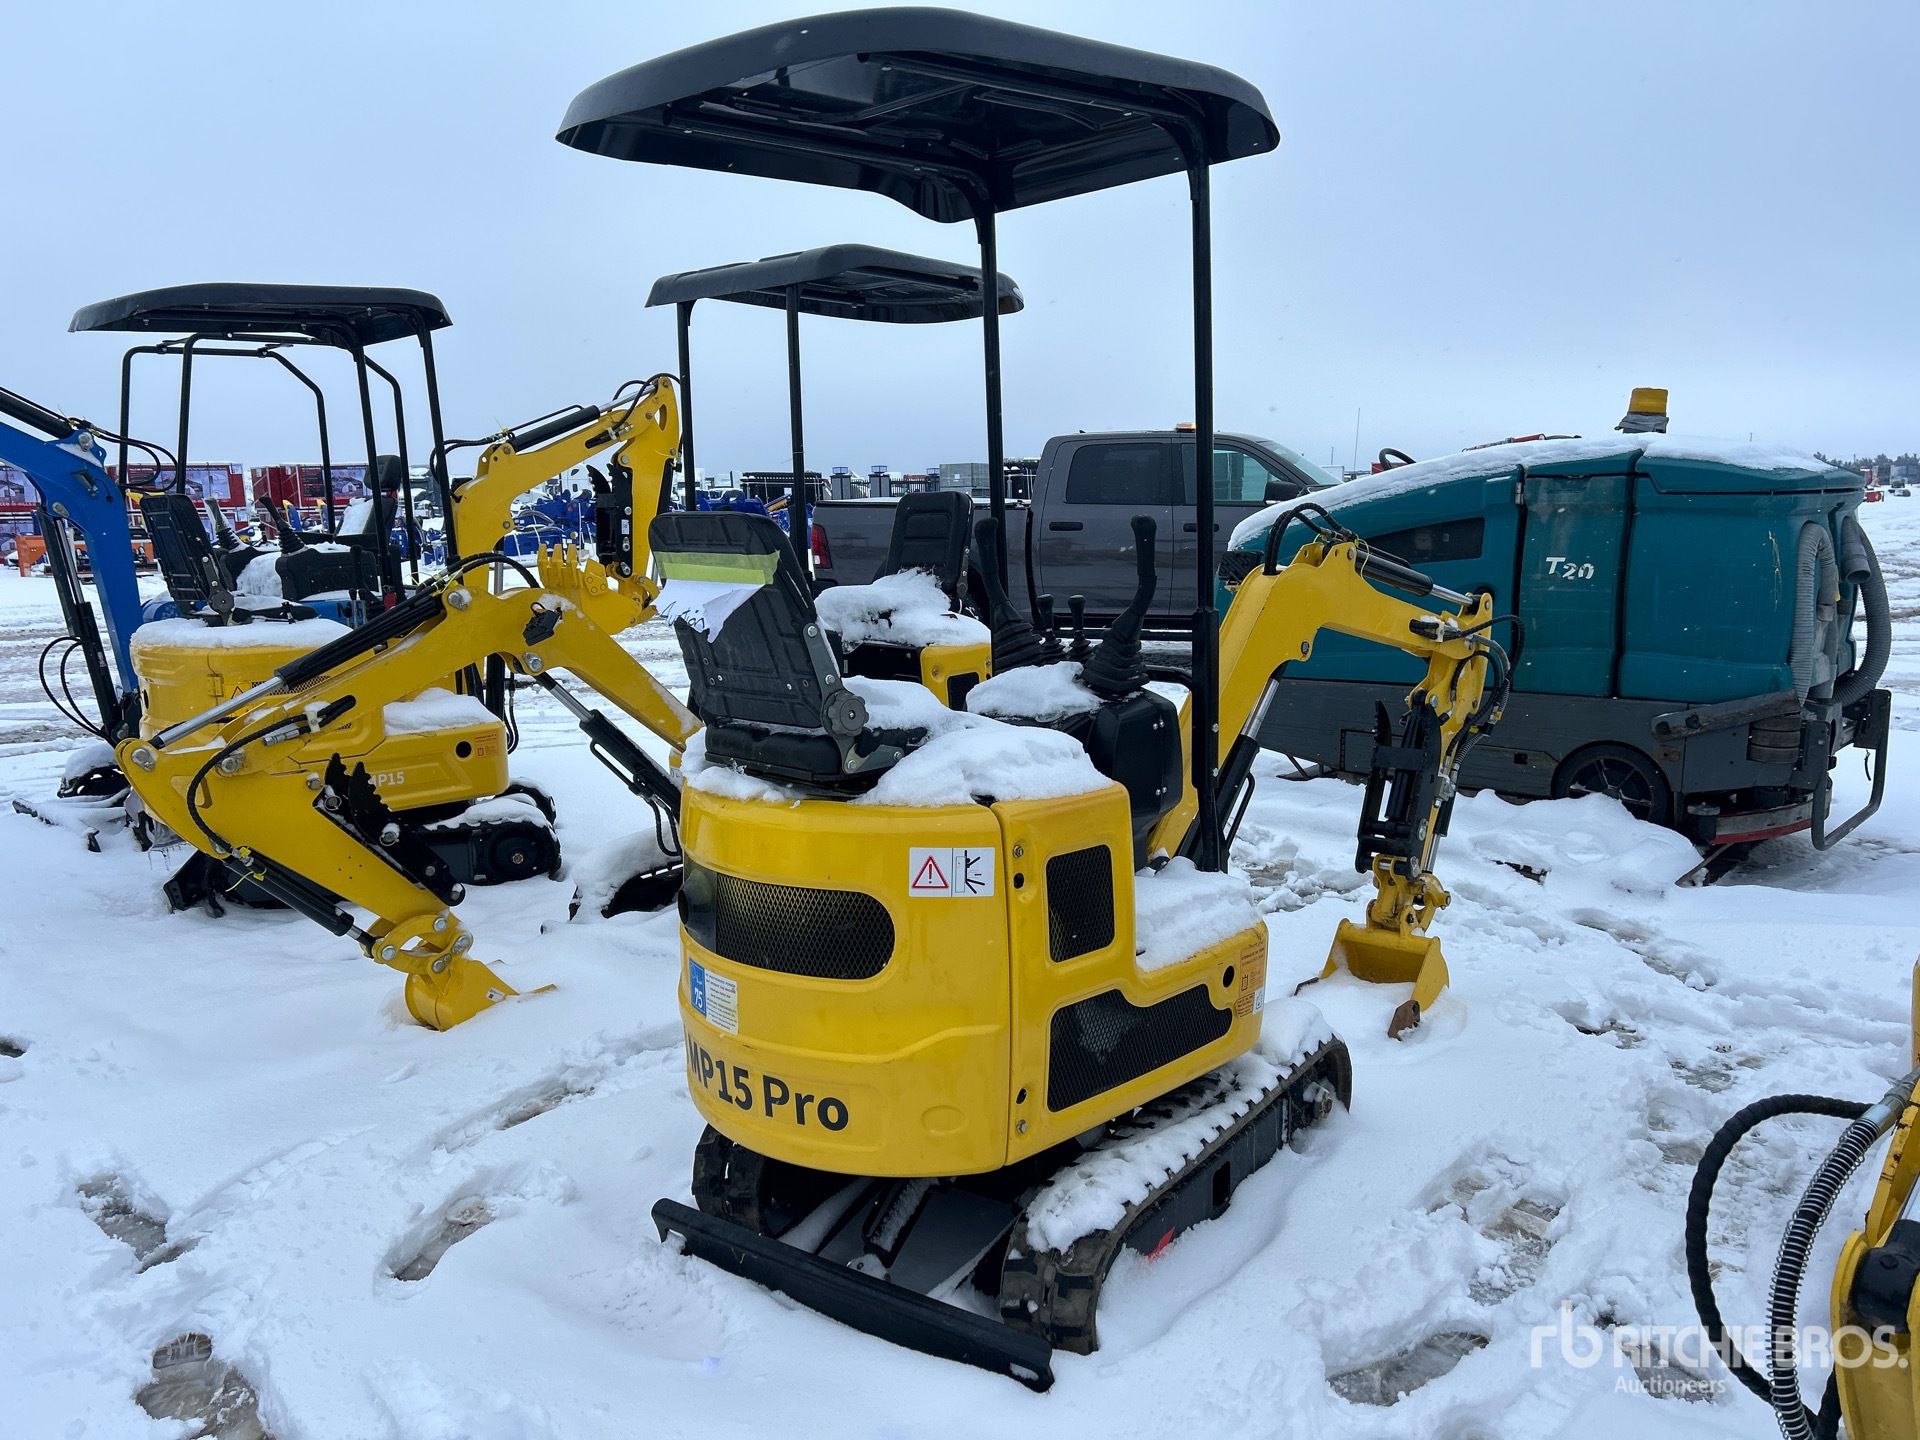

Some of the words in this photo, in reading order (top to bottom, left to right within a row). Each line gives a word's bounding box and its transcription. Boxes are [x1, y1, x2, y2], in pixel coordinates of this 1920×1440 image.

[1545, 556, 1595, 580] T20
[659, 600, 705, 629] Aution
[694, 987, 703, 1009] 75
[687, 1033, 753, 1111] MP15
[762, 1074, 849, 1131] Pro
